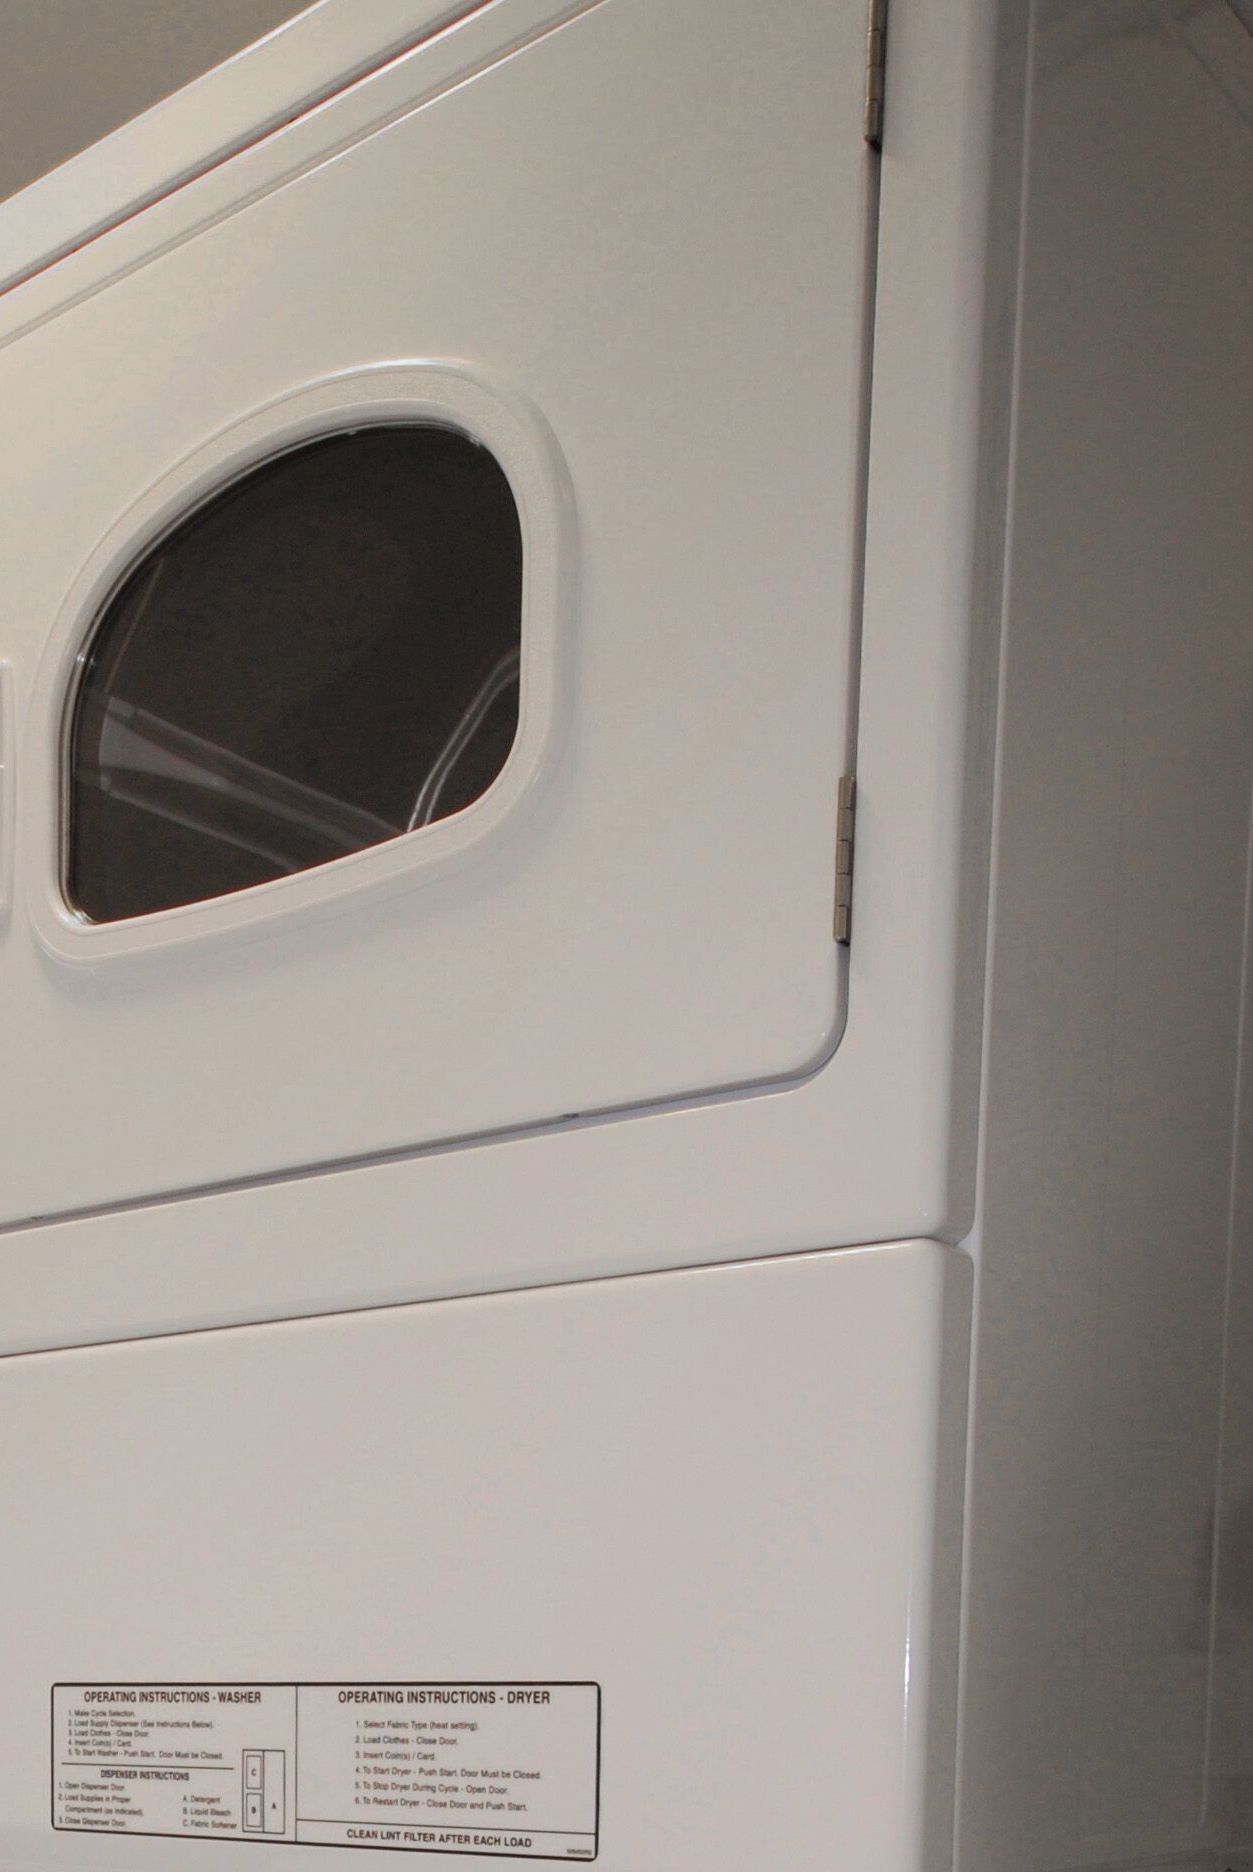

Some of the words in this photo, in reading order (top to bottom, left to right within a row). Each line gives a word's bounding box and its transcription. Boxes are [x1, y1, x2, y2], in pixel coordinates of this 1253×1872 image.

[84, 1691, 137, 1703] OPERATING
[139, 1691, 210, 1703] INSTRUCTIONS
[218, 1691, 262, 1703] WASHER
[338, 1691, 404, 1704] OPERATING
[407, 1691, 496, 1704] INSTRUCTIONS
[507, 1691, 550, 1704] DRYER
[363, 1720, 385, 1728] Select
[387, 1720, 409, 1729] Fabric
[411, 1720, 427, 1731] Type
[363, 1736, 381, 1744] Load
[383, 1736, 409, 1745] Clothes
[416, 1736, 437, 1745] Close
[363, 1751, 383, 1759] Insert
[100, 1769, 138, 1779] DISPENSER
[139, 1770, 189, 1781] INSTRUCTIONS
[251, 1768, 257, 1776] C
[363, 1766, 371, 1774] To
[373, 1766, 390, 1775] Start
[391, 1766, 411, 1777] Dryer
[418, 1767, 437, 1776] Push
[460, 1768, 478, 1777] Door
[481, 1769, 499, 1778] Must
[501, 1769, 510, 1778] be
[363, 1781, 371, 1790] To
[373, 1781, 389, 1791] Stop
[390, 1782, 410, 1792] Dryer
[412, 1783, 437, 1793] During
[437, 1784, 459, 1794] Cycle
[466, 1784, 486, 1794] Open
[271, 1802, 277, 1810] A
[363, 1796, 371, 1805] To
[373, 1797, 398, 1806] Restart
[400, 1798, 420, 1808] Dryer
[426, 1799, 447, 1808] Close
[449, 1800, 468, 1809] Door
[469, 1800, 484, 1810] and
[486, 1801, 505, 1810] Push
[251, 1806, 256, 1814] B
[346, 1828, 378, 1839] CLEAN
[380, 1830, 401, 1840] LINT
[404, 1831, 436, 1842] FILTER
[438, 1833, 471, 1844] AFTER
[473, 1835, 501, 1846] EACH
[504, 1837, 532, 1848] LOAD
